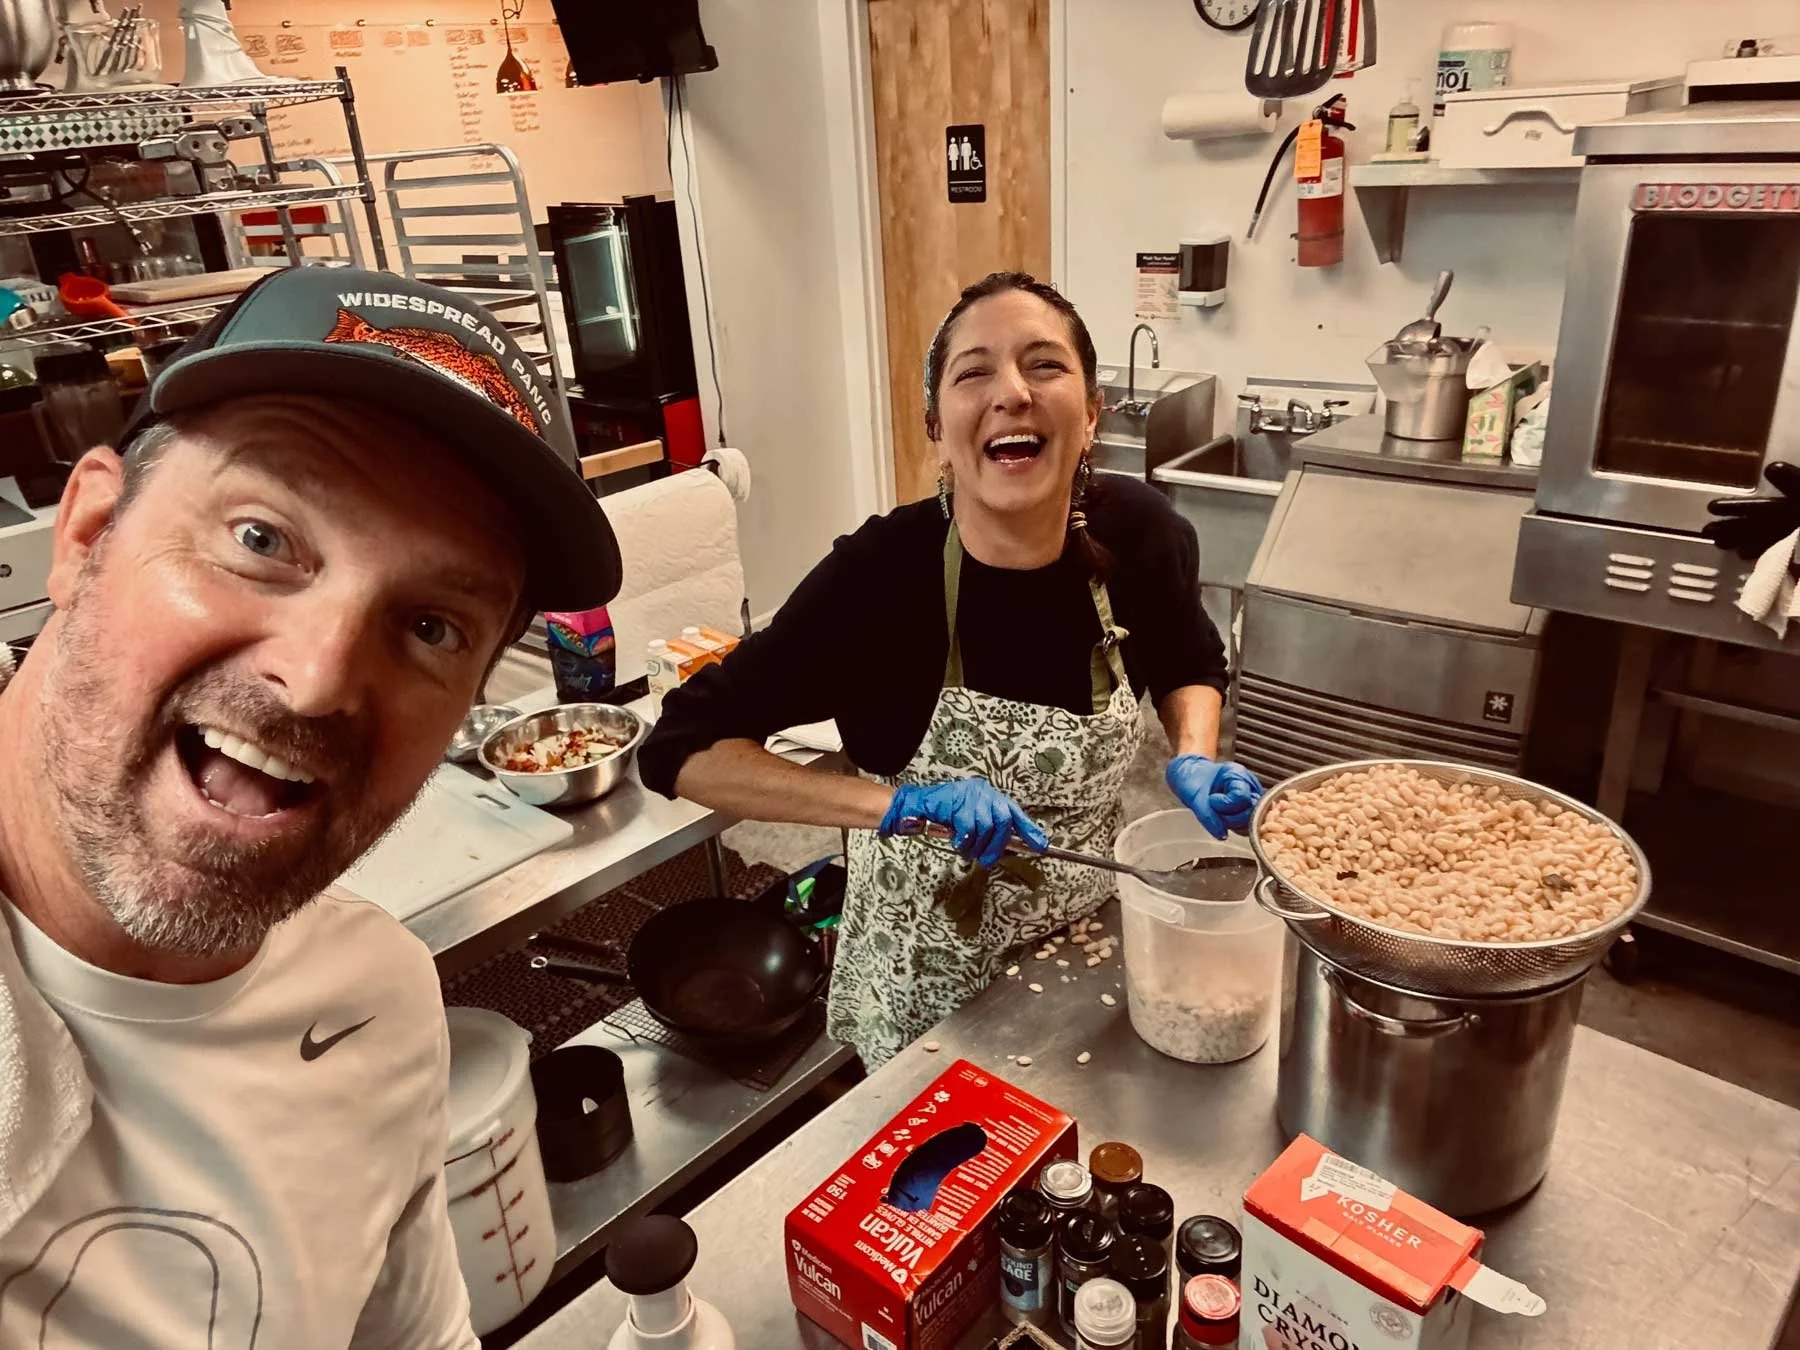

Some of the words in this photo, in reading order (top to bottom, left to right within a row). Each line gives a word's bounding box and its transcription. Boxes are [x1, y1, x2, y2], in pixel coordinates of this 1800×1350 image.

[338, 293, 506, 356] WIDESPREAD
[512, 358, 552, 425] PANIC
[825, 1183, 848, 1201] 150
[874, 1205, 907, 1228] GLOVES
[858, 1212, 925, 1269] Vulcan
[1337, 1195, 1422, 1249] KOSHER
[793, 1252, 841, 1300] Vulcan
[853, 1239, 897, 1273] Medicom
[914, 1270, 964, 1325] Vulcan
[1253, 1275, 1360, 1350] DIAMO
